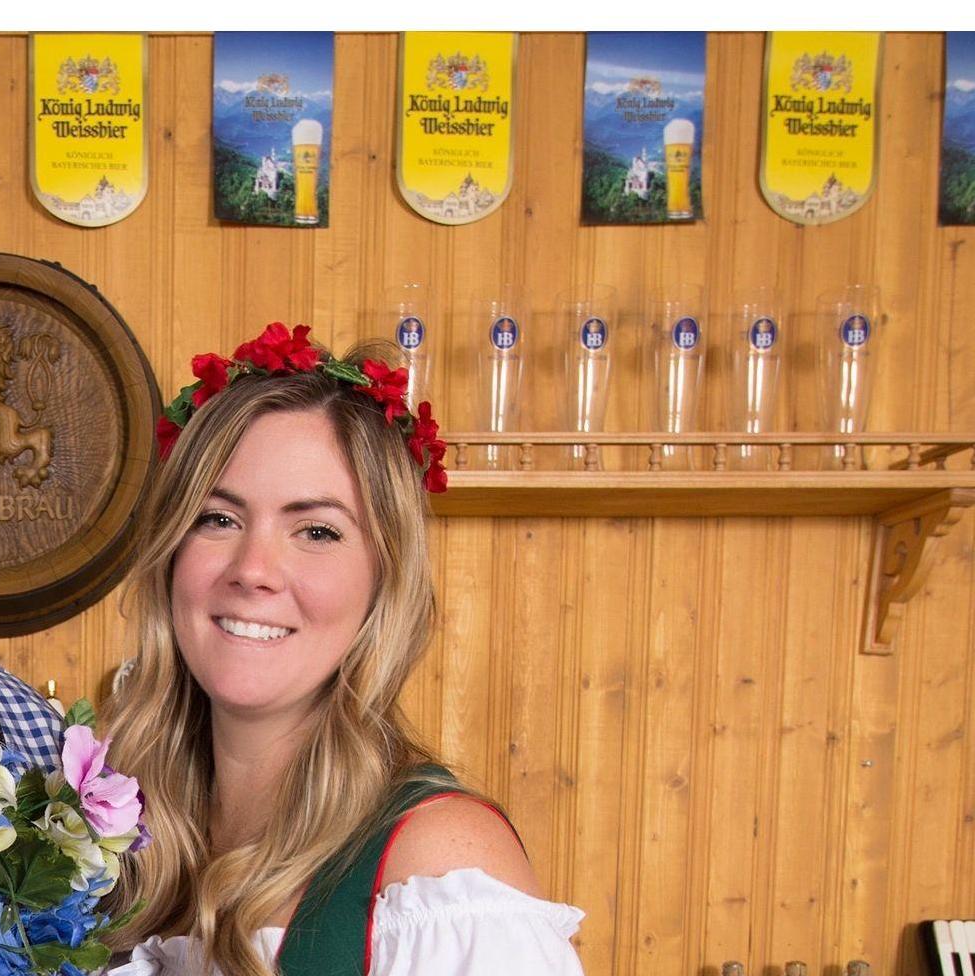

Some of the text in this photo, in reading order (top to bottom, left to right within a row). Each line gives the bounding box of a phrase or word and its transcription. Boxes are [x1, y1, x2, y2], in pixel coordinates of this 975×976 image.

[38, 98, 141, 121] König Ludwig
[406, 94, 508, 119] König Ludwig
[770, 94, 871, 121] König Ludwig
[52, 120, 128, 138] Weissbier
[420, 117, 495, 136] Weissbier
[784, 118, 858, 137] Weissbier
[402, 332, 420, 346] HB
[497, 332, 513, 346] HB
[586, 333, 603, 347] HB
[679, 332, 695, 346] HB
[756, 333, 772, 347] HB
[848, 329, 865, 344] HB
